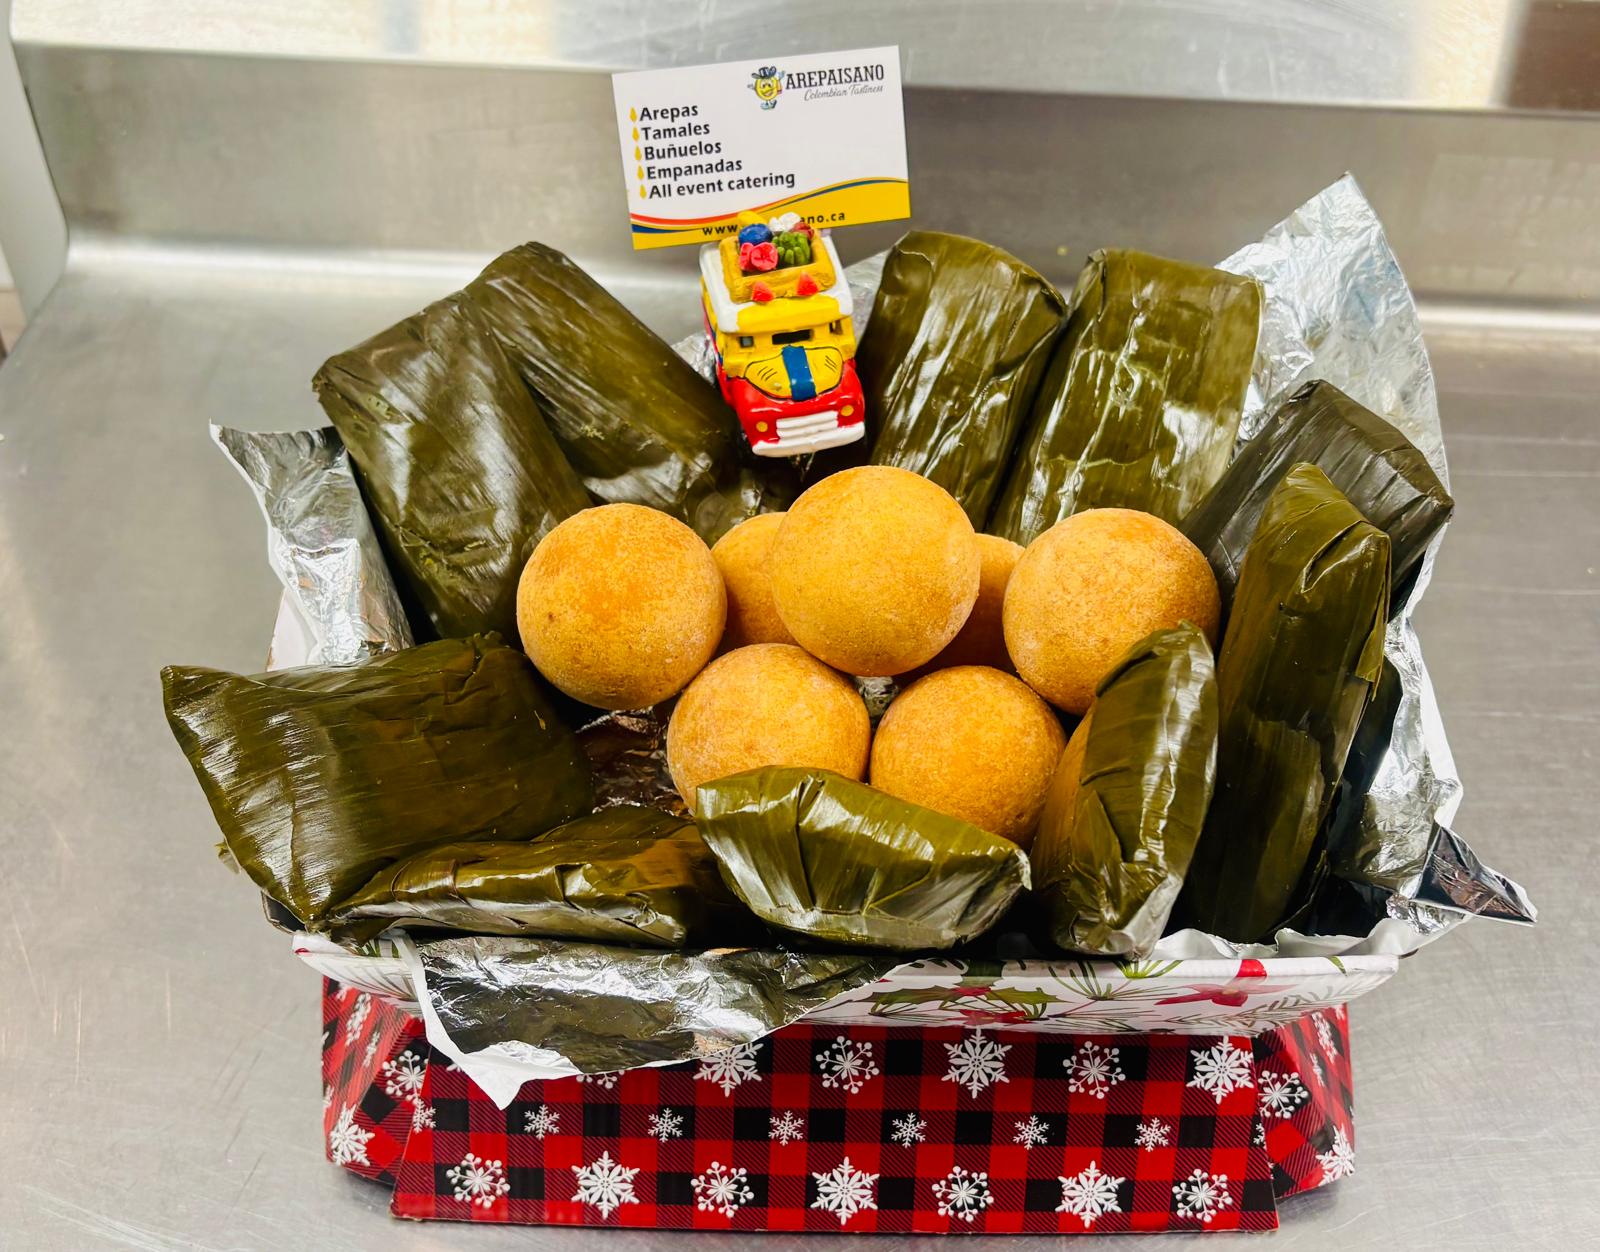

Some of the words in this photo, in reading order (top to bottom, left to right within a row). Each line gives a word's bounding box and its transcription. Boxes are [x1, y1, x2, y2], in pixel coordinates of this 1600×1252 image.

[785, 64, 885, 90] AREPAISANO
[803, 87, 848, 101] Colombian
[848, 83, 884, 97] Tastiness
[639, 104, 699, 123] Arepas
[641, 122, 711, 141] Tamales
[644, 141, 722, 161] Buñuelos
[646, 158, 743, 182] Empanadas
[648, 184, 672, 200] All
[676, 180, 724, 196] event
[727, 173, 796, 189] catering
